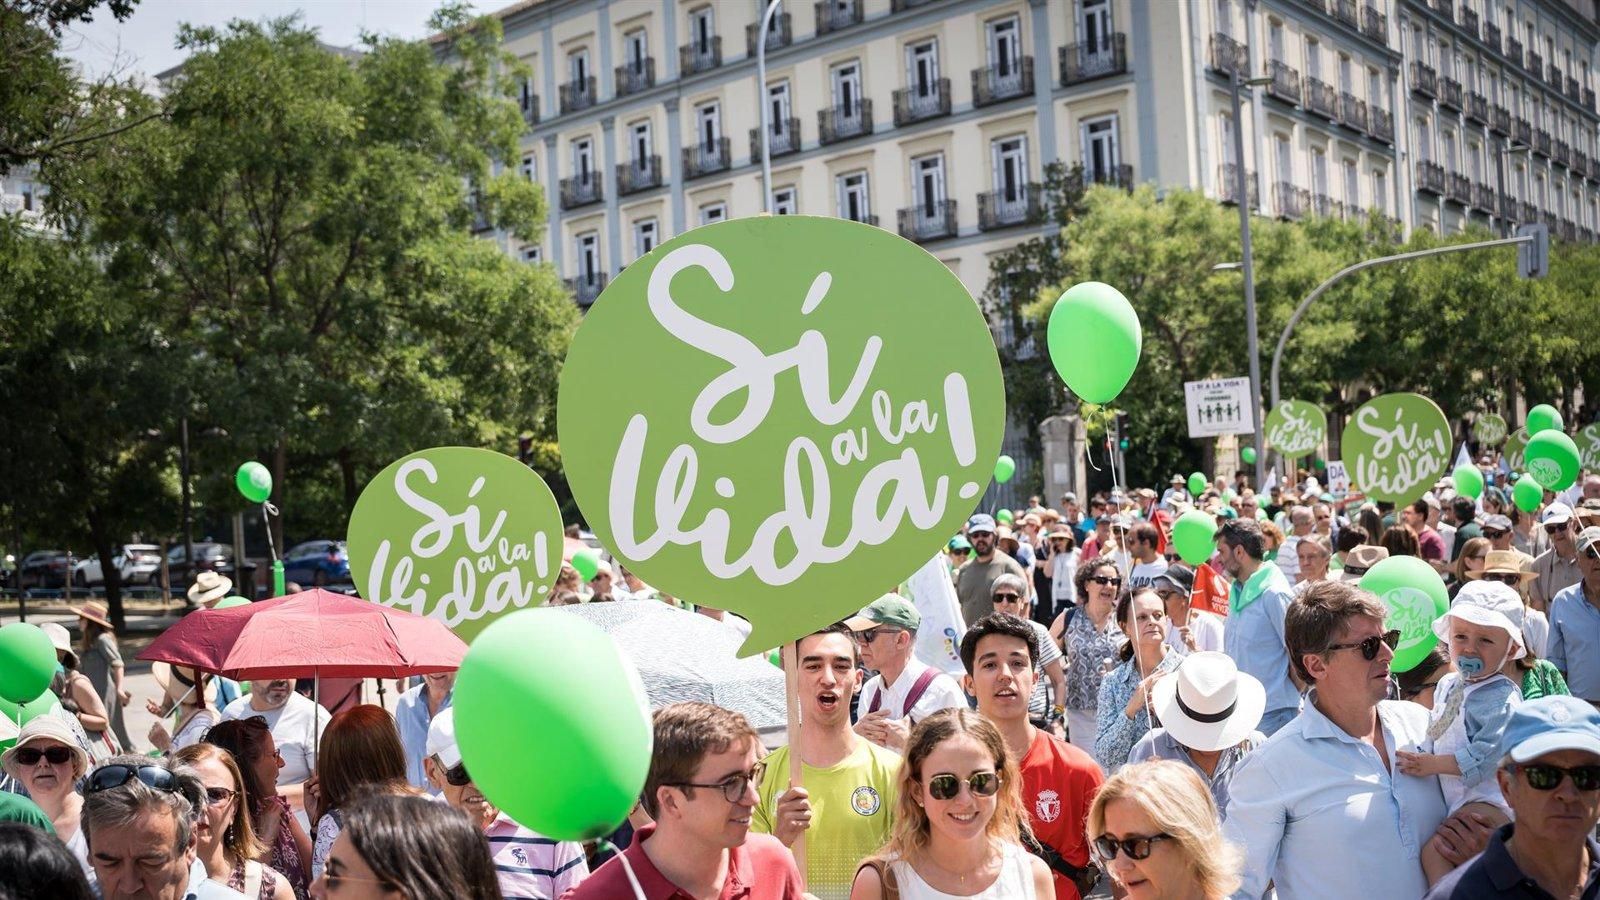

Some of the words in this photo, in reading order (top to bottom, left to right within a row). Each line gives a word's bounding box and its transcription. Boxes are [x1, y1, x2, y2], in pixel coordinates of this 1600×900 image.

[648, 244, 882, 444] Sí
[831, 427, 868, 465] a
[872, 390, 938, 444] la
[1357, 406, 1418, 459] Sí
[395, 457, 507, 558] Sí
[477, 554, 496, 573] a
[498, 537, 531, 565] la
